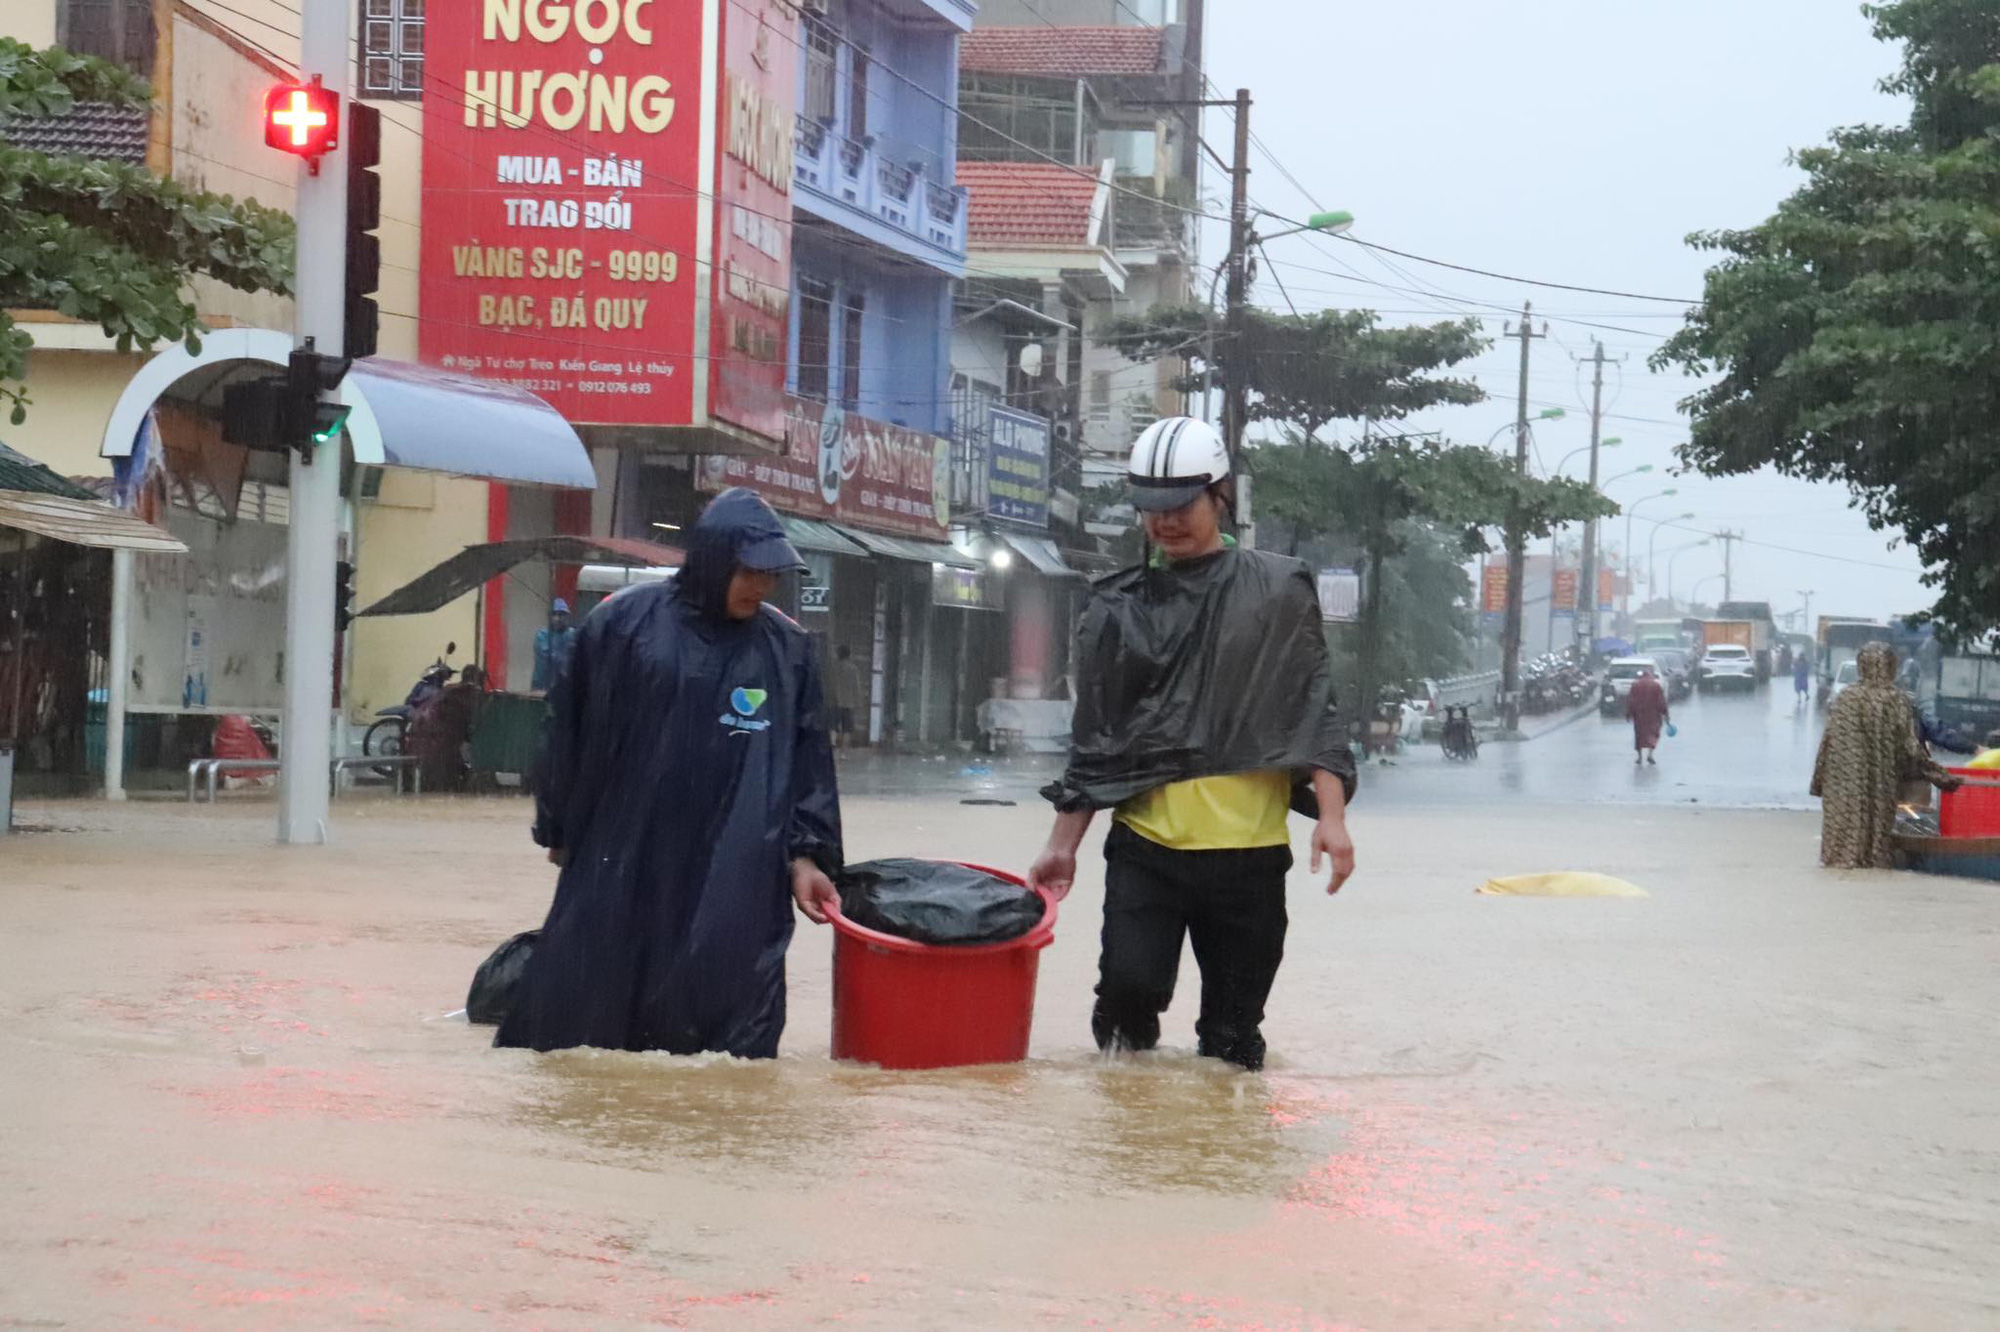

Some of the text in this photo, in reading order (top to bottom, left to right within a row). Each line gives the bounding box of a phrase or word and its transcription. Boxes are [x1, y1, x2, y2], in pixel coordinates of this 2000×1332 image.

[483, 0, 653, 65] NGỌC
[464, 69, 675, 134] HƯƠNG
[497, 155, 563, 185] MUA
[503, 198, 579, 229] TRAO
[452, 238, 524, 278] VÀNG
[530, 247, 584, 279] SJC
[608, 249, 678, 282] 9999
[550, 291, 587, 328] ĐÁ
